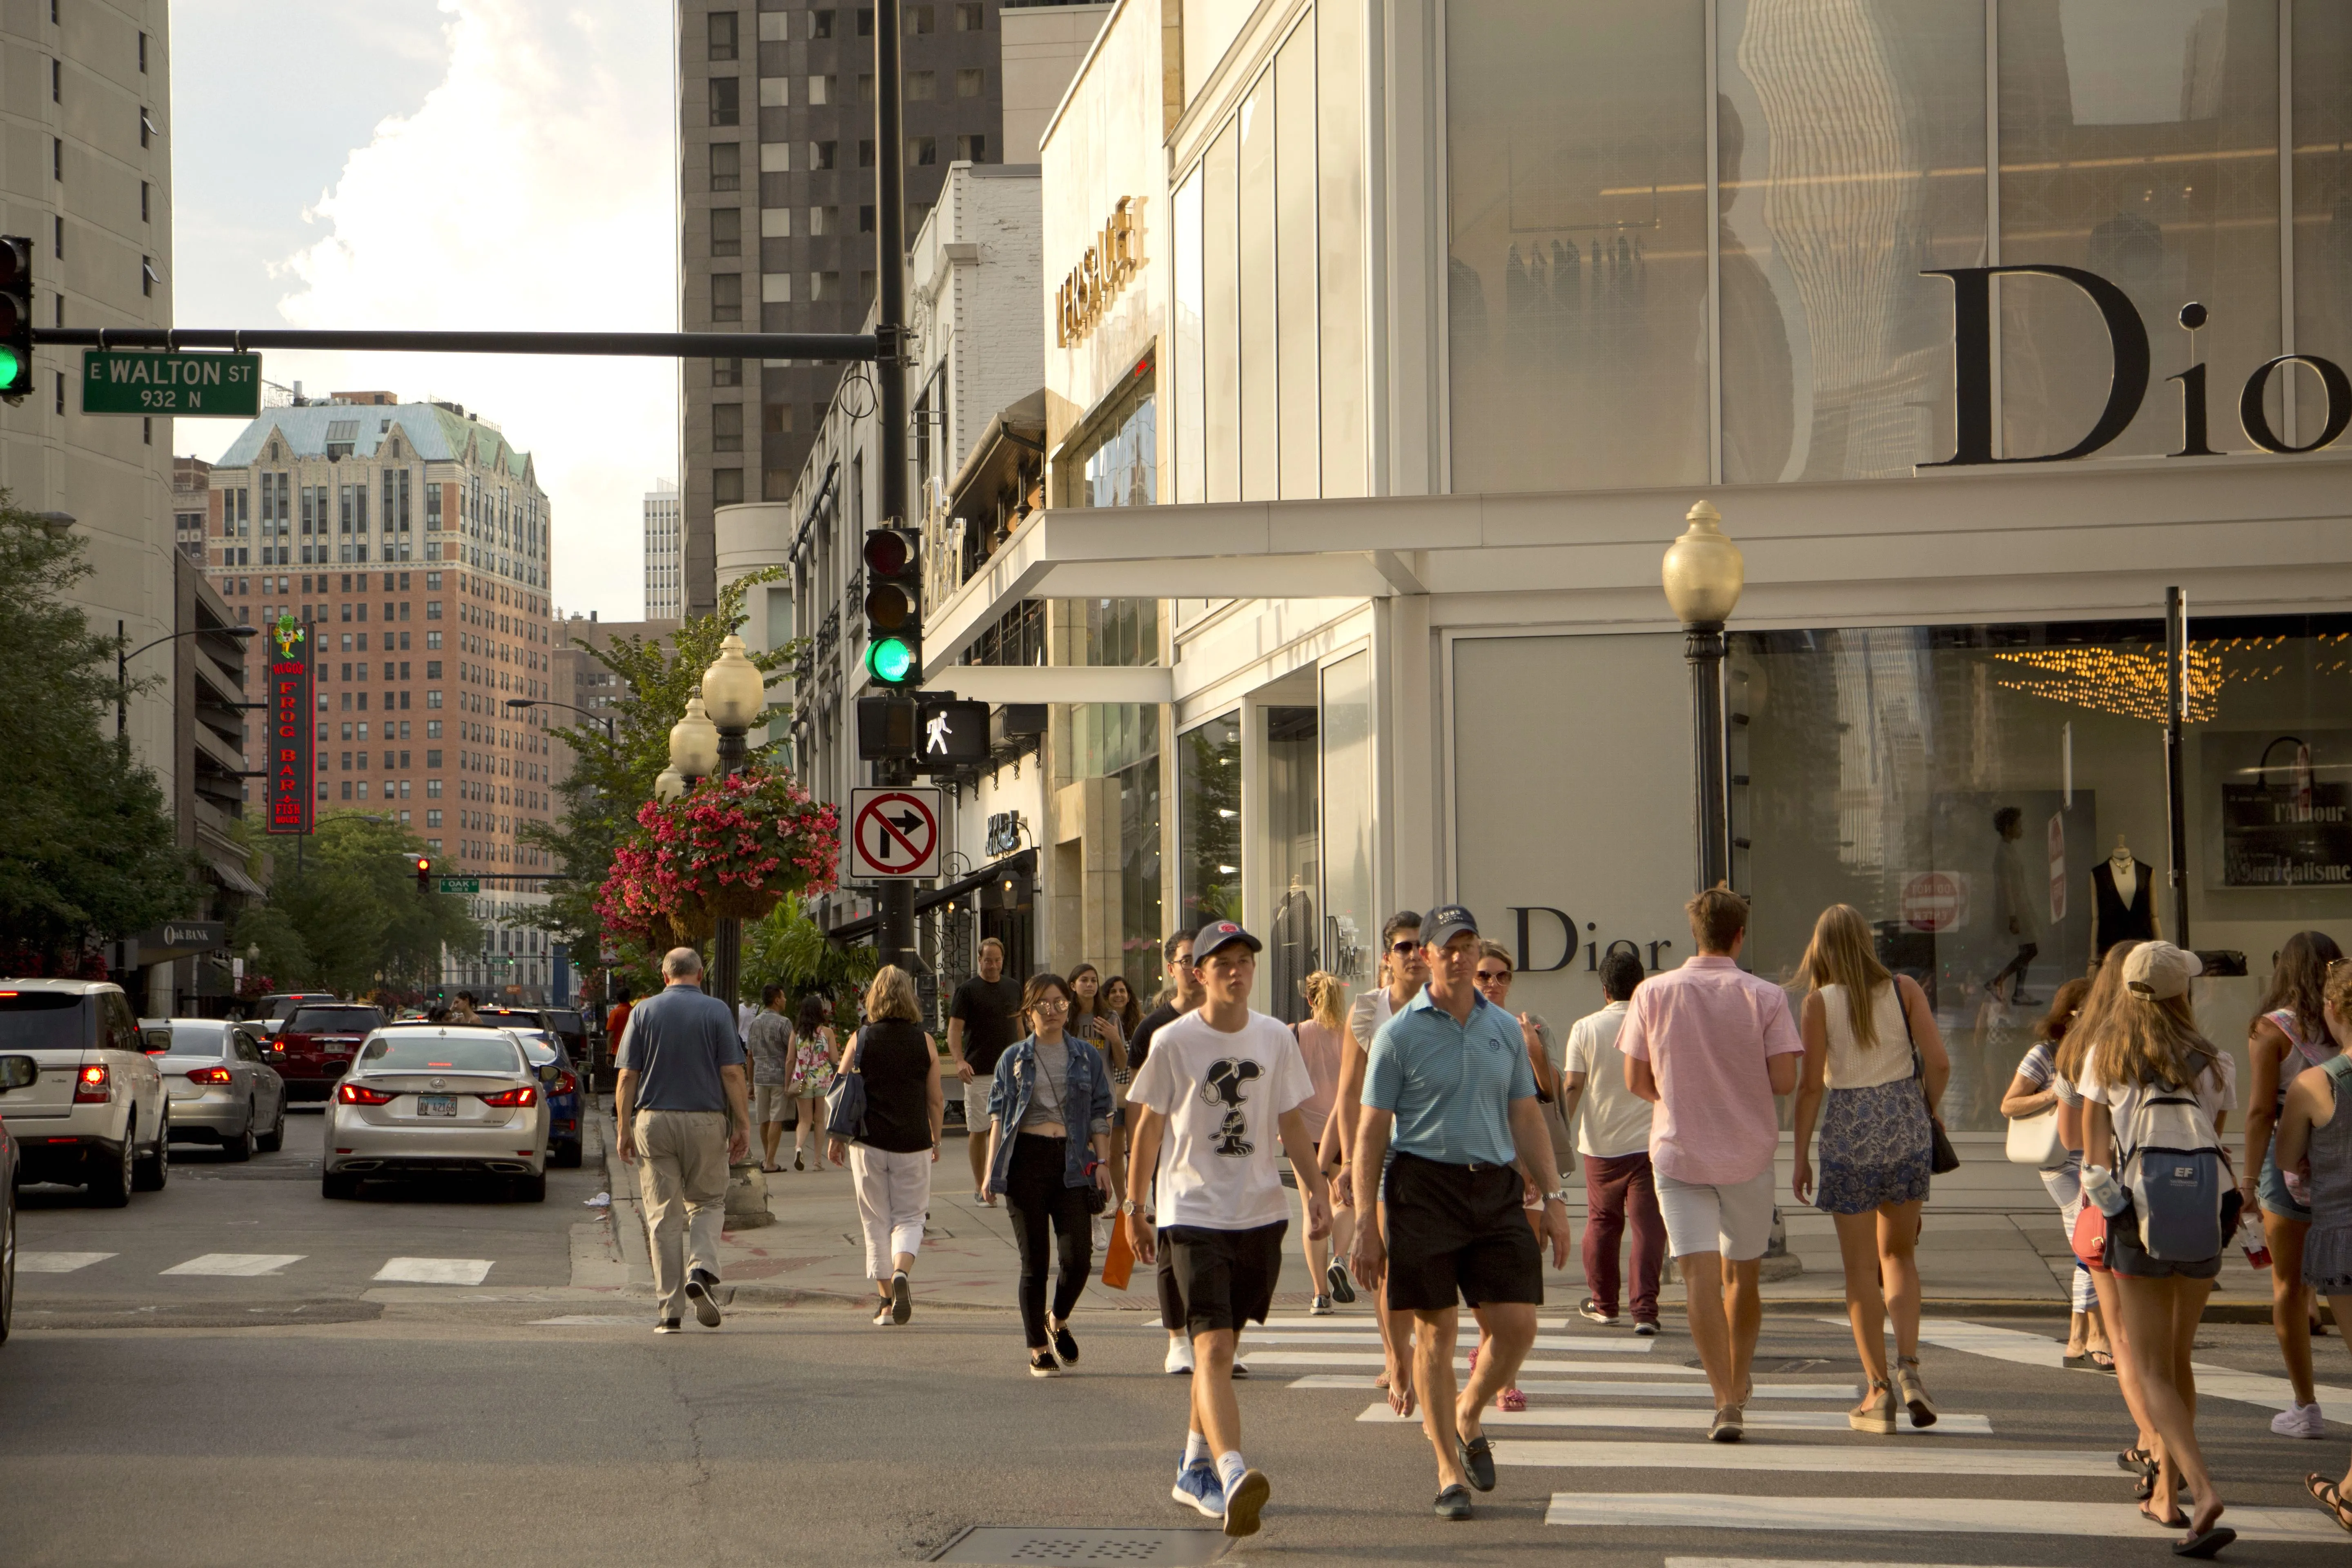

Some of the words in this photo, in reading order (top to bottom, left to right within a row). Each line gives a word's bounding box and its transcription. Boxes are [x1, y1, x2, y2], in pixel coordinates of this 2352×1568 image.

[91, 363, 101, 379] E
[110, 360, 220, 385] WALTON
[228, 366, 251, 382] ST
[141, 390, 176, 407] 932
[189, 392, 201, 408] N
[272, 660, 304, 675] HUGO'S
[279, 682, 297, 737] FROG
[279, 750, 296, 791] BAR
[275, 804, 300, 814] FISH
[185, 929, 209, 940] BANK
[433, 1103, 455, 1112] 42166
[2175, 1167, 2194, 1177] EF
